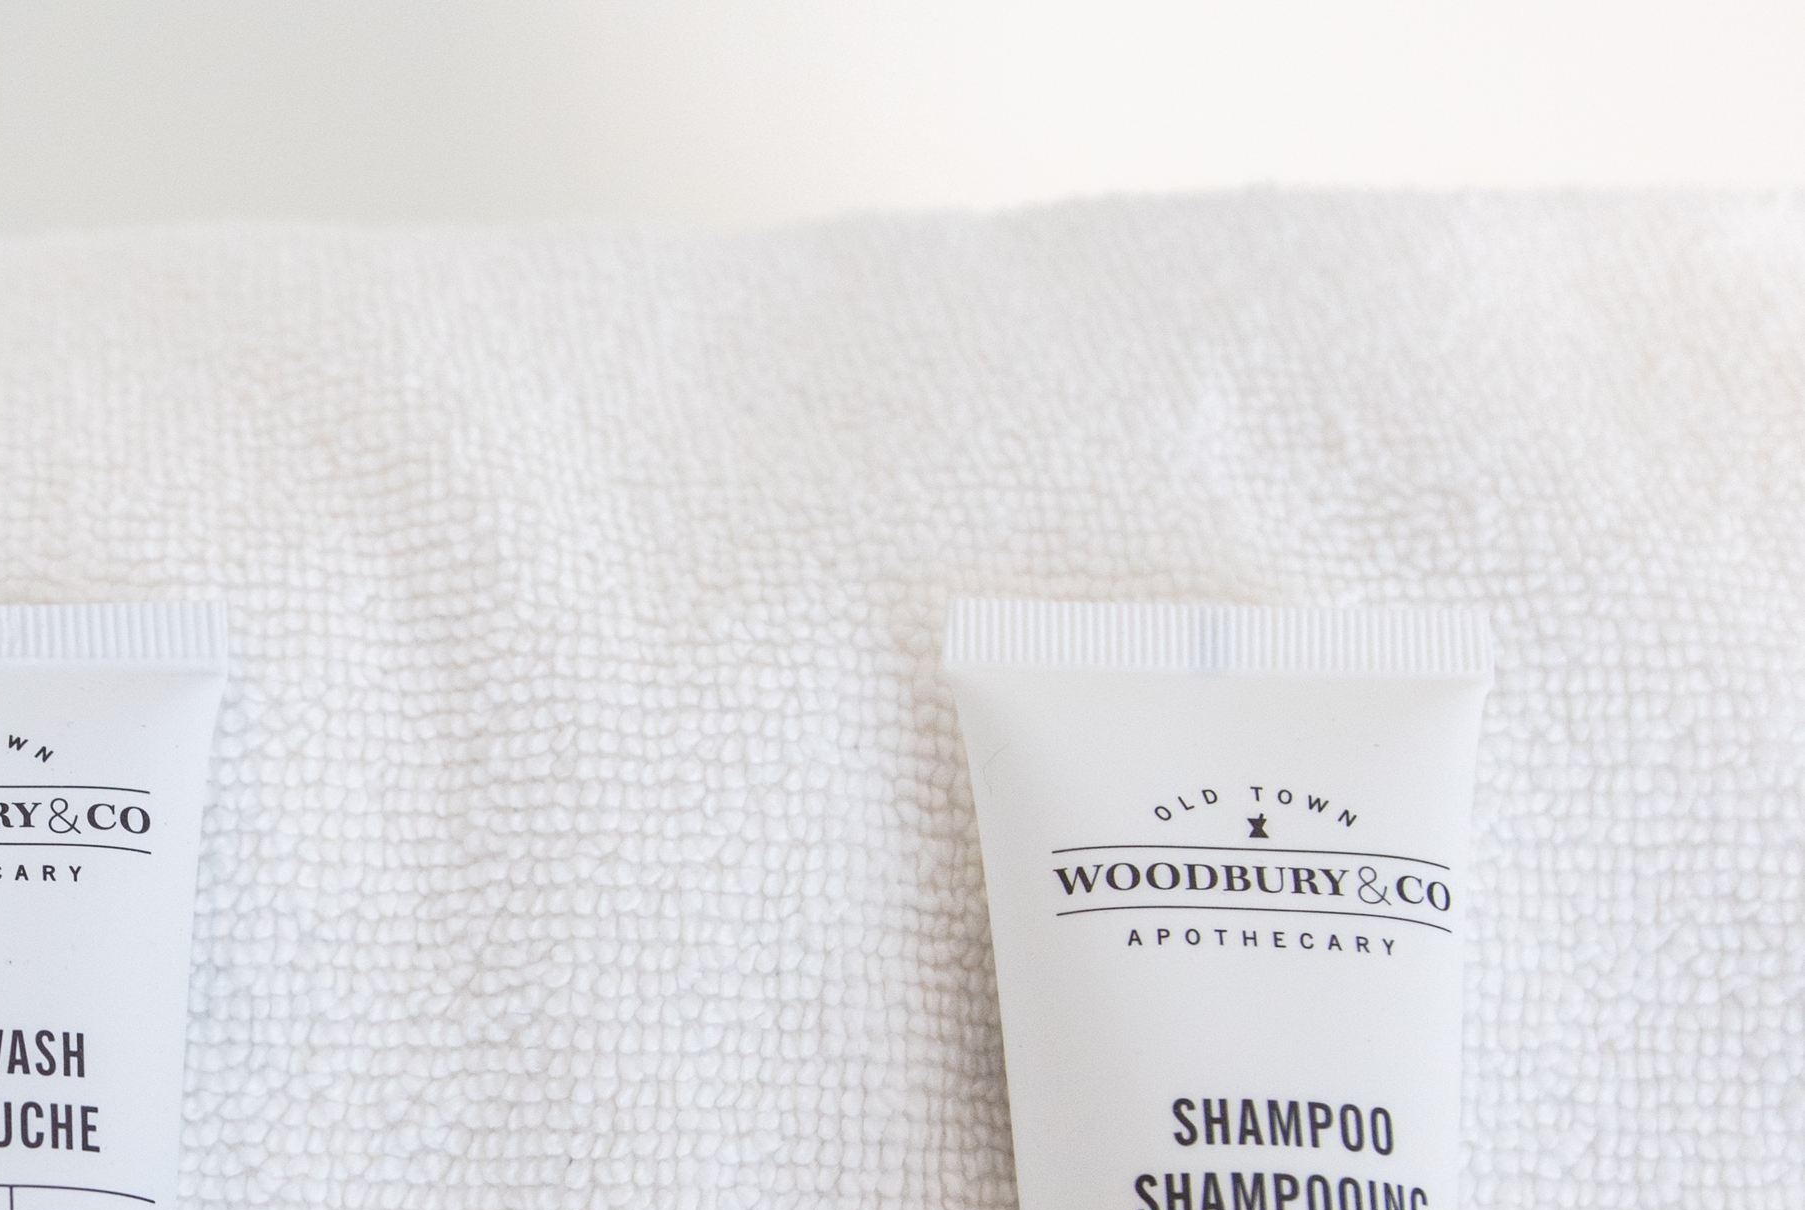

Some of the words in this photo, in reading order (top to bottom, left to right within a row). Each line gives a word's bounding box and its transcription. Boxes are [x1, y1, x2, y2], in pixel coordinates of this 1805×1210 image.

[1154, 789, 1218, 821] OLD
[1249, 786, 1357, 828] TOWN
[1127, 928, 1394, 955] APOTHECARY
[1171, 1098, 1394, 1156] SHAMPOO
